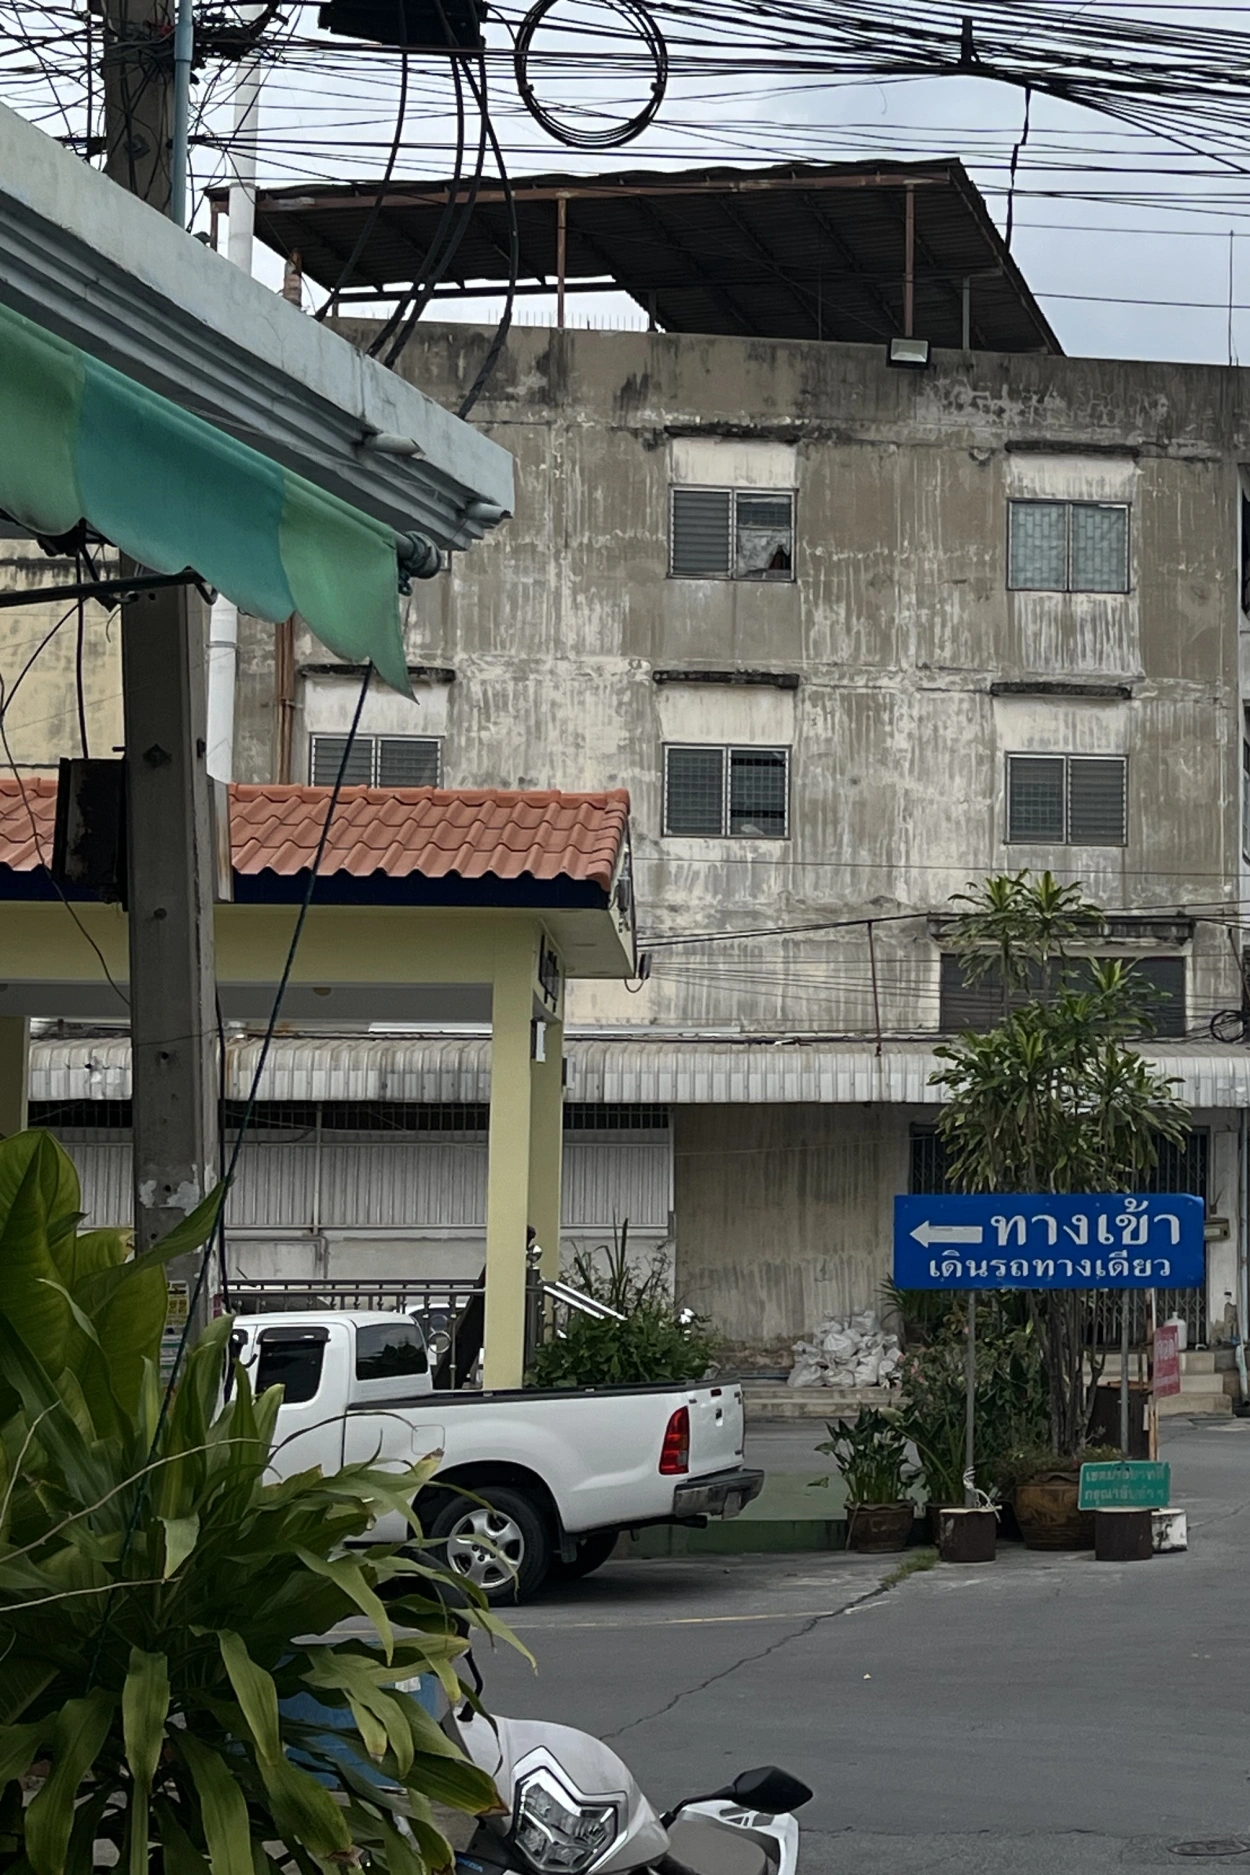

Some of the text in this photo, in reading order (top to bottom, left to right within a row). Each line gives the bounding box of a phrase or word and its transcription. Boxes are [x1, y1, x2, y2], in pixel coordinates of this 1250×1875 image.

[990, 1198, 1181, 1246] ทางเข้า
[929, 1249, 1171, 1278] เดินรถทางเดียว
